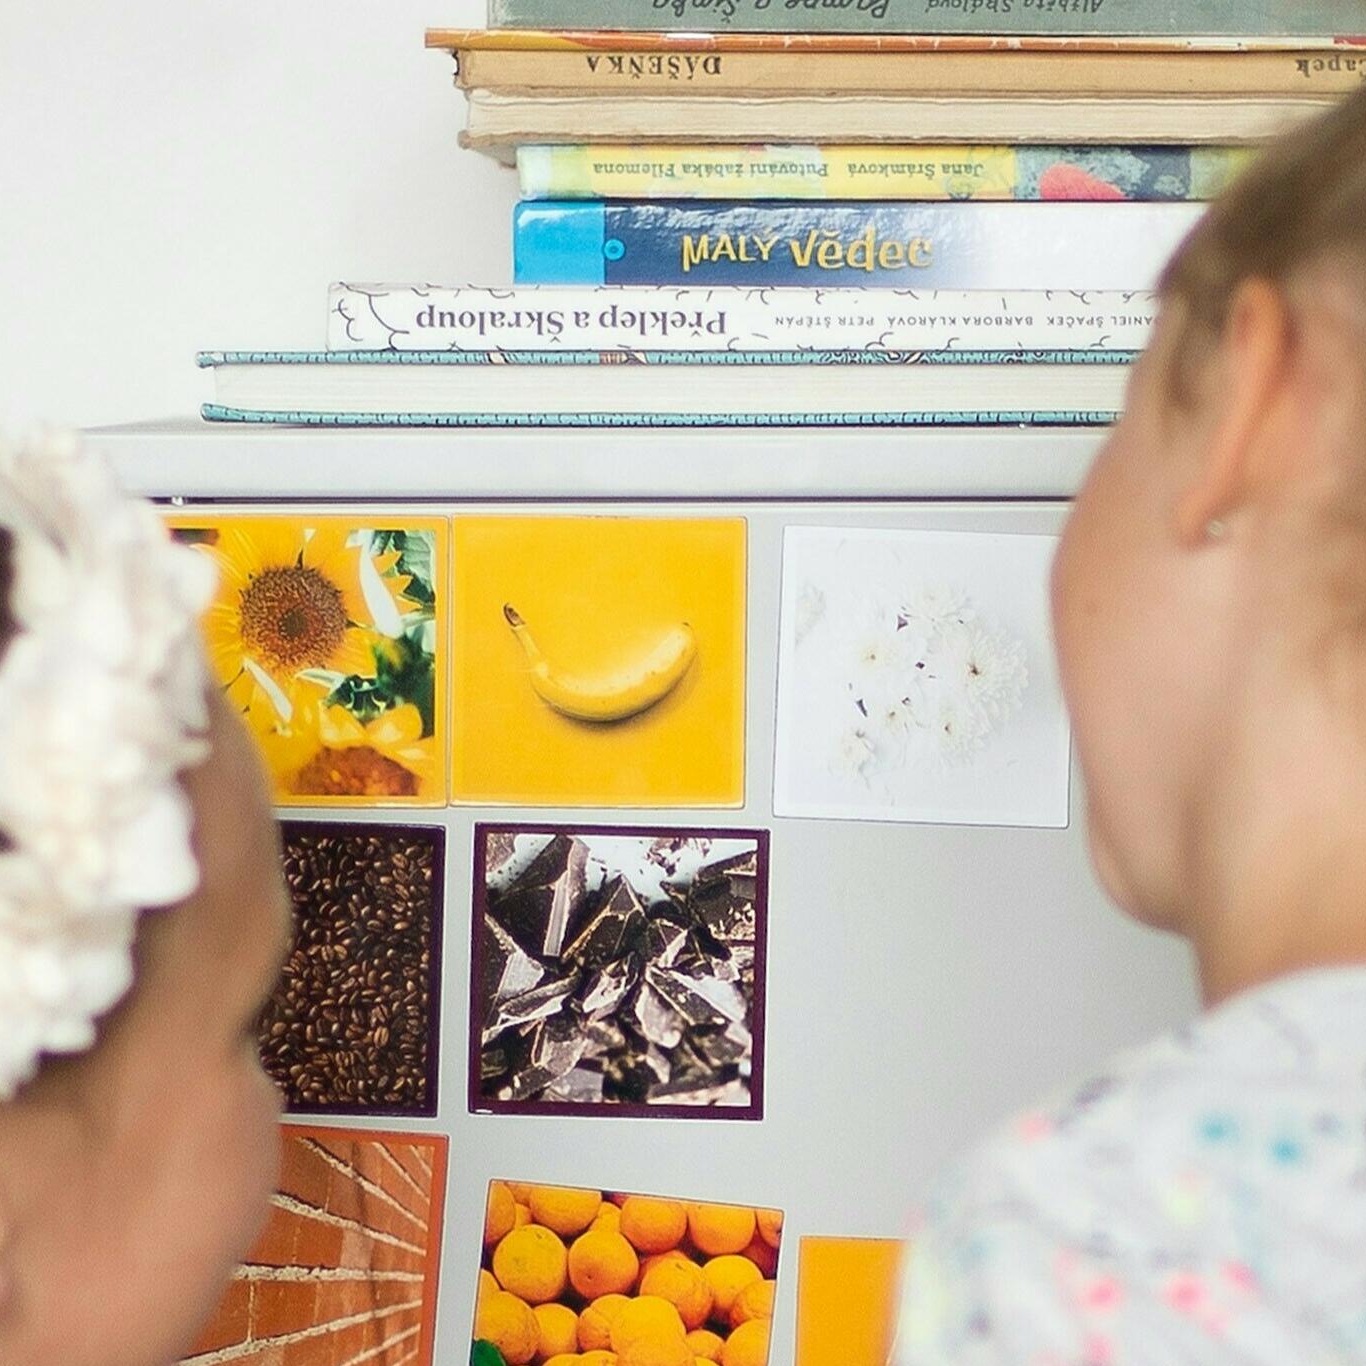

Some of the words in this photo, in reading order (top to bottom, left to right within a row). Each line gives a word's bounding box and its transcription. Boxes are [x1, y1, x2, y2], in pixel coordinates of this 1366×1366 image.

[586, 55, 722, 80] DÁŠEŇKA
[593, 163, 676, 178] Filemona
[682, 163, 744, 178] žabáka
[750, 163, 829, 178] Putování
[847, 163, 935, 180] Šrámková
[941, 163, 984, 177] Jana
[416, 305, 565, 343] Škraloup
[574, 311, 590, 327] a
[599, 305, 727, 337] Překlep
[838, 316, 875, 326] PETR
[887, 316, 957, 328] KLÁROVÁ
[963, 316, 1034, 326] BARBORA
[1046, 316, 1104, 328] ŠPAČEK
[1110, 316, 1154, 326] ANIEL
